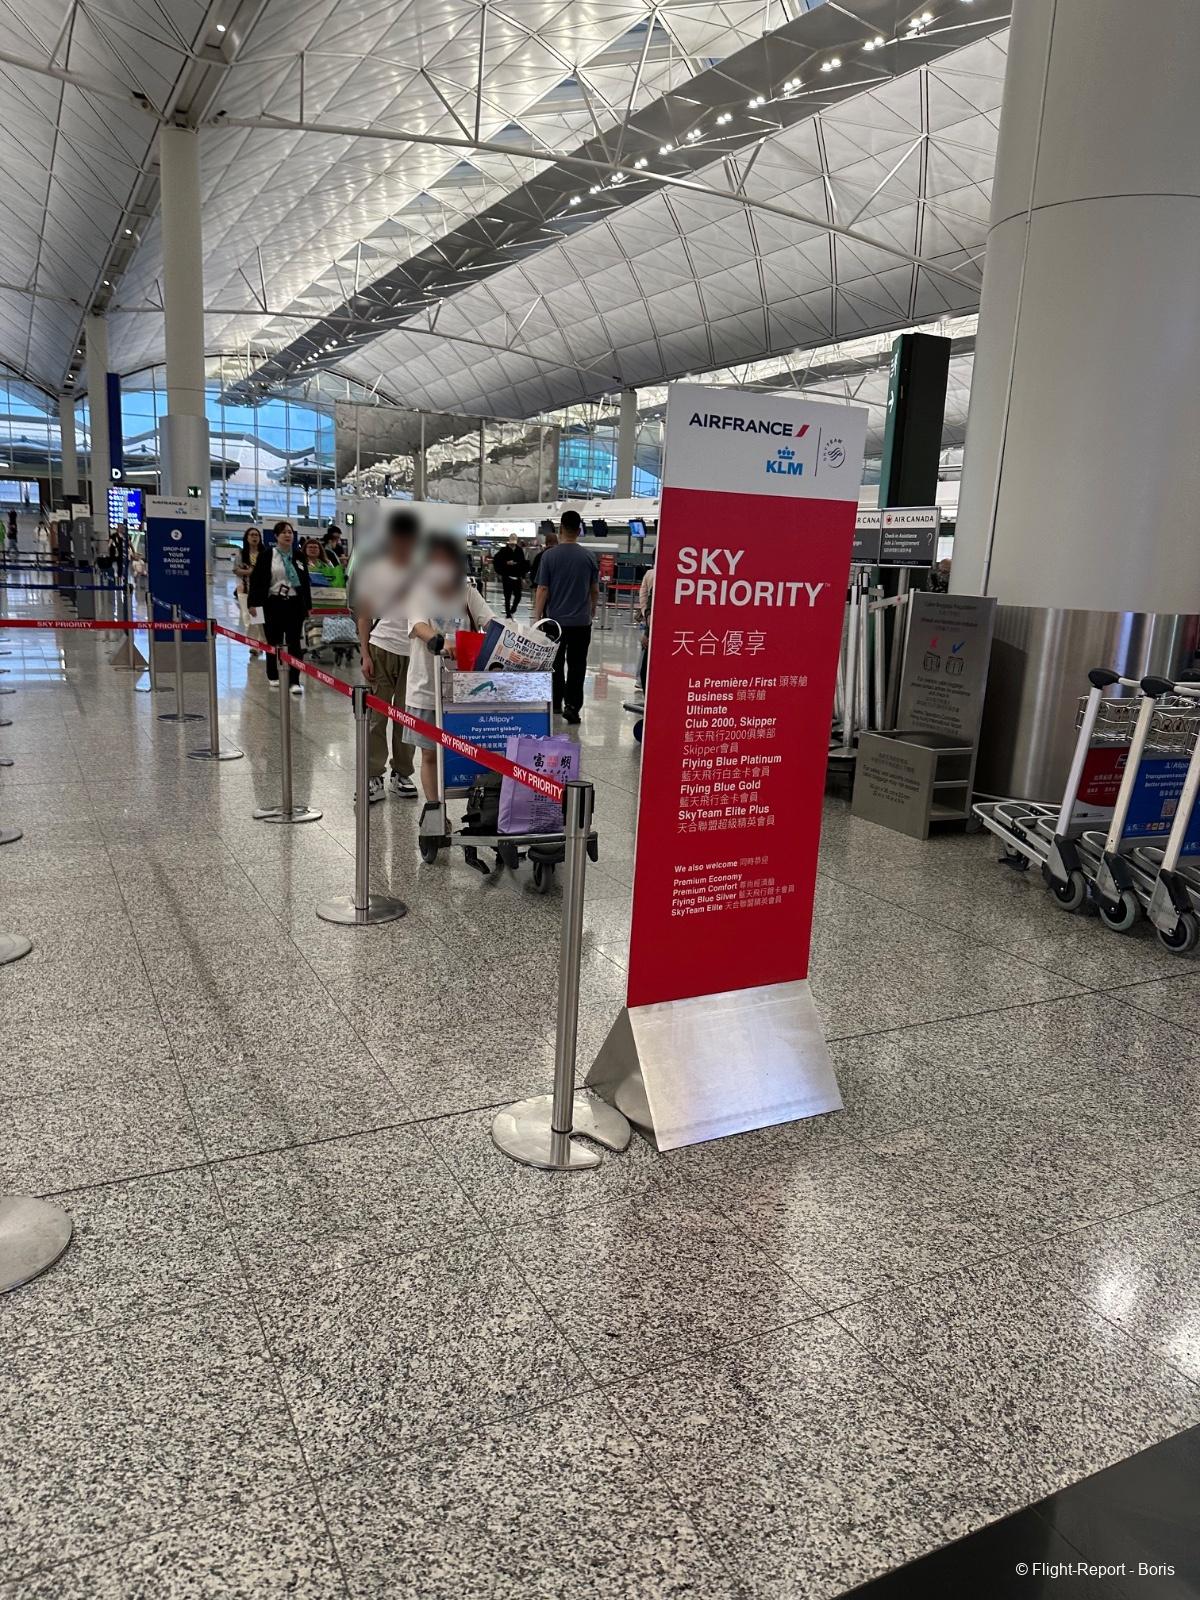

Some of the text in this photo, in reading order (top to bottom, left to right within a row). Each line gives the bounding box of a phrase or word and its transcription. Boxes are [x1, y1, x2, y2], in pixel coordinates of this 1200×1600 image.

[689, 412, 794, 437] AIRFRANCE
[112, 468, 122, 479] D
[766, 459, 804, 476] KLM
[906, 515, 934, 523] CANADA
[676, 546, 745, 576] SKY
[671, 629, 767, 656] 天合優享
[688, 678, 701, 688] La
[687, 691, 734, 702] Business
[387, 706, 416, 728] SKY PRIORITY
[686, 705, 728, 715] Ultimate
[685, 716, 777, 729] Club 2000, Skipper
[441, 732, 478, 758] SKY PRIORITY
[682, 755, 782, 770] Flying Blue Platinum
[513, 766, 528, 782] SKY
[528, 774, 564, 800] PRIORITY
[680, 780, 761, 796] Flying Blue Gold
[678, 804, 770, 821] SkyTeam Elite Plus
[674, 865, 686, 873] We
[706, 860, 738, 870] welcome
[673, 873, 742, 887] Premium Economy
[672, 887, 706, 896] Premium
[708, 883, 738, 892] Comfort
[672, 898, 695, 907] Flying
[697, 895, 714, 903] Blue
[716, 892, 737, 901] Silver
[671, 906, 705, 917] SkyTeam
[706, 903, 723, 912] Elite
